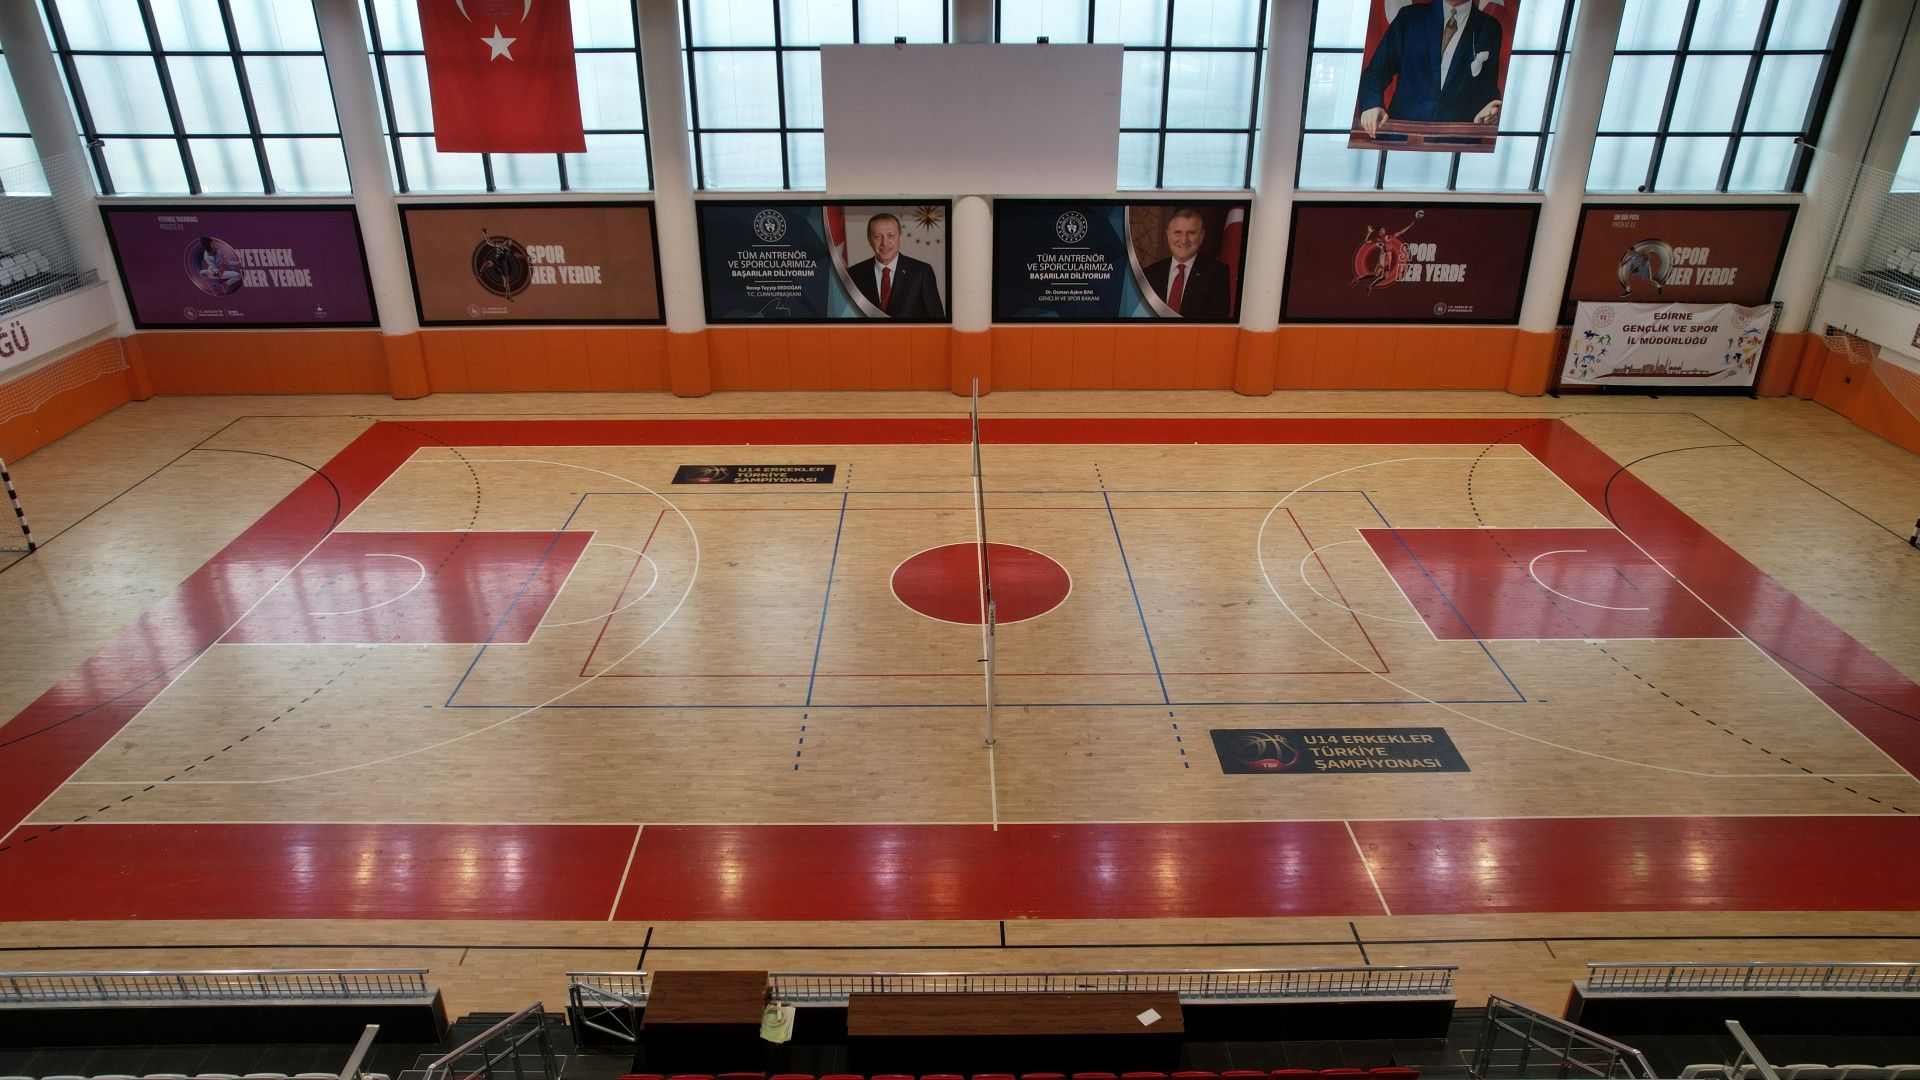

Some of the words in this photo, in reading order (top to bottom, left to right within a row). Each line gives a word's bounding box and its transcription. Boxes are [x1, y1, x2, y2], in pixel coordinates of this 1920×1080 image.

[234, 248, 295, 266] YETENEK
[526, 244, 566, 264] SPOR
[737, 250, 758, 259] TÜM
[760, 250, 807, 259] ANTRENÖR
[1037, 253, 1056, 262] TÜM
[1059, 253, 1105, 262] ANTRENÖR
[1399, 242, 1437, 262] SPOR
[1672, 246, 1710, 266] SPOR
[728, 260, 738, 268] VE
[740, 260, 817, 268] SPORCULARIMIZA
[269, 269, 312, 287] YERDE
[529, 266, 557, 284] HER
[558, 266, 602, 284] YERDE
[732, 270, 772, 278] BAŞARILAR
[1426, 264, 1467, 282] YERDE
[1666, 268, 1693, 285] HER
[1696, 268, 1738, 285] YERDE
[1654, 312, 1693, 320] EDİRNE
[1622, 324, 1669, 333] GENÇLİK
[1627, 336, 1636, 344] İL
[1640, 336, 1708, 345] MÜDÜRLÜĞÜ
[1302, 736, 1338, 744] U14
[1343, 734, 1434, 744] ERKEKLER
[1309, 746, 1388, 757] TÜRKİYE
[1314, 758, 1442, 770] ŞAMPİYONASI
